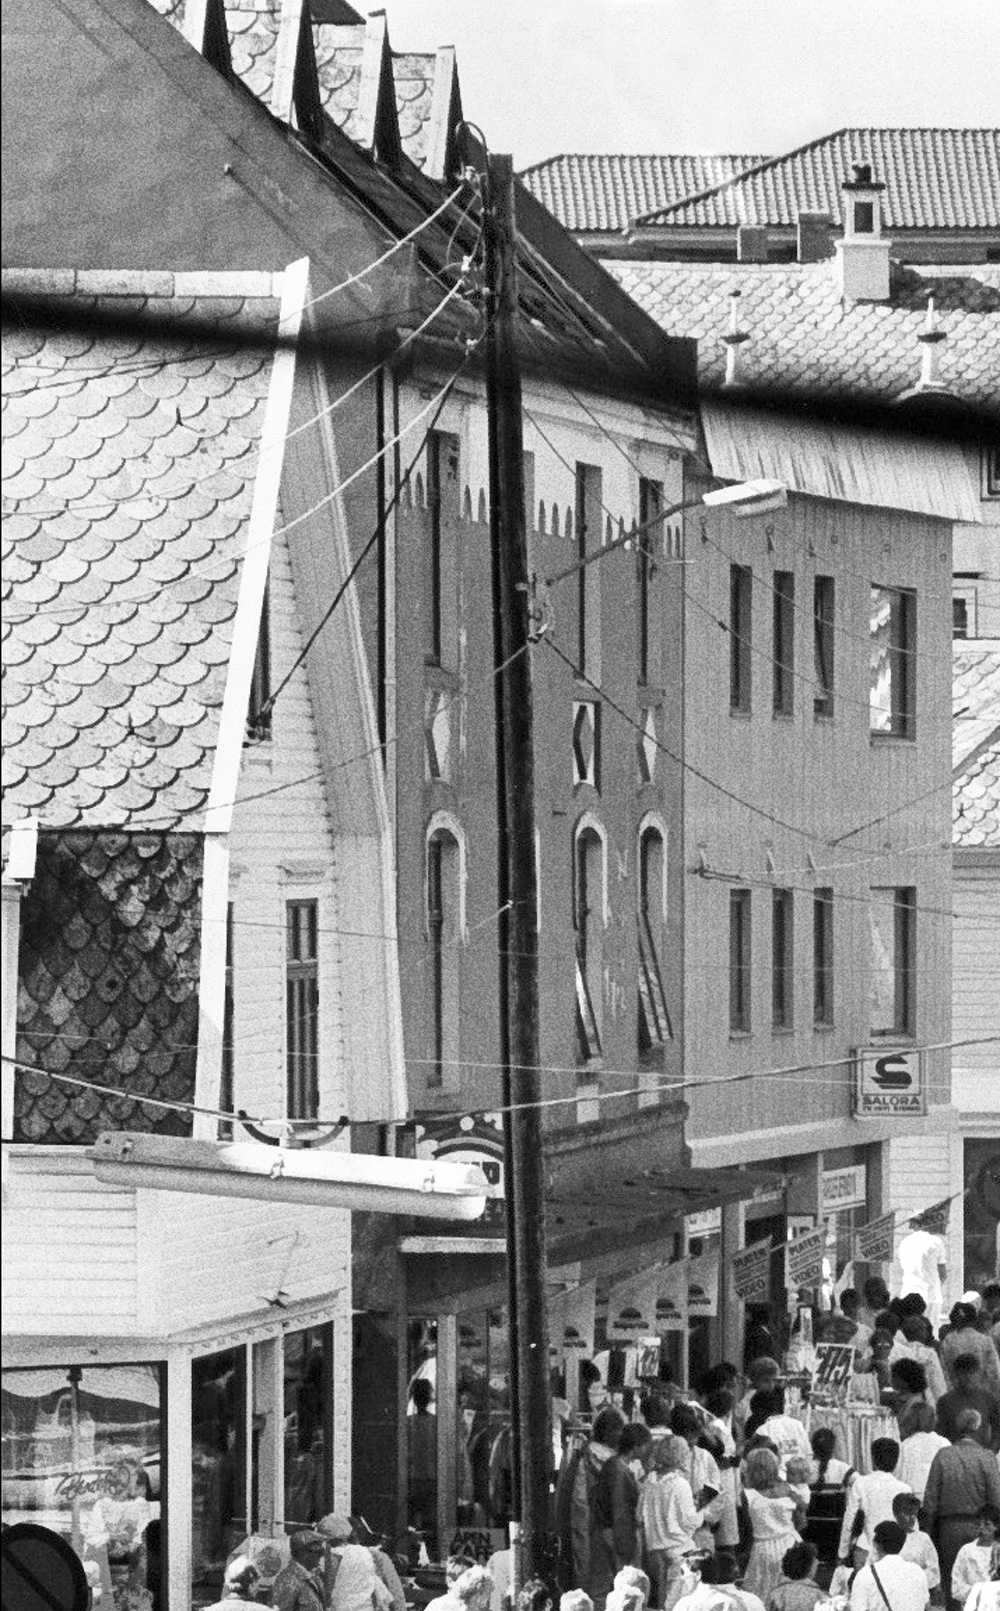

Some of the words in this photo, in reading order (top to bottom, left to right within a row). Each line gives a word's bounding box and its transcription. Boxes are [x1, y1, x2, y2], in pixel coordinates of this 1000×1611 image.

[862, 1096, 920, 1106] SALORA
[860, 1240, 890, 1259] VIDEO
[790, 1264, 820, 1285] VIDEO
[734, 1278, 767, 1299] VIDEO
